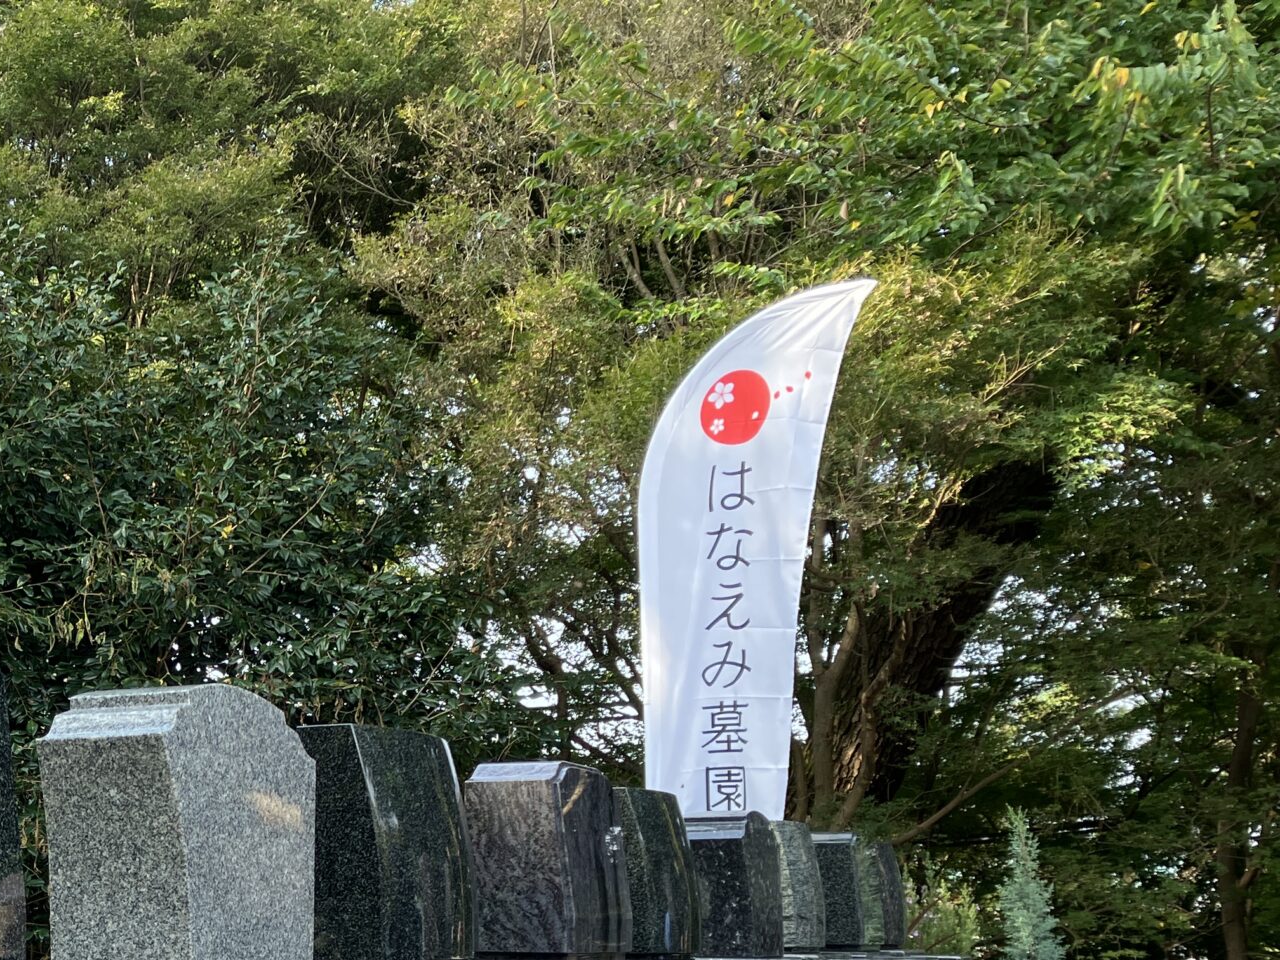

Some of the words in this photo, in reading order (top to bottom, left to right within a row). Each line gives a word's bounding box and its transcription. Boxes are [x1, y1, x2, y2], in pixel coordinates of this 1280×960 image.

[700, 460, 756, 812] はなえみ墓園
